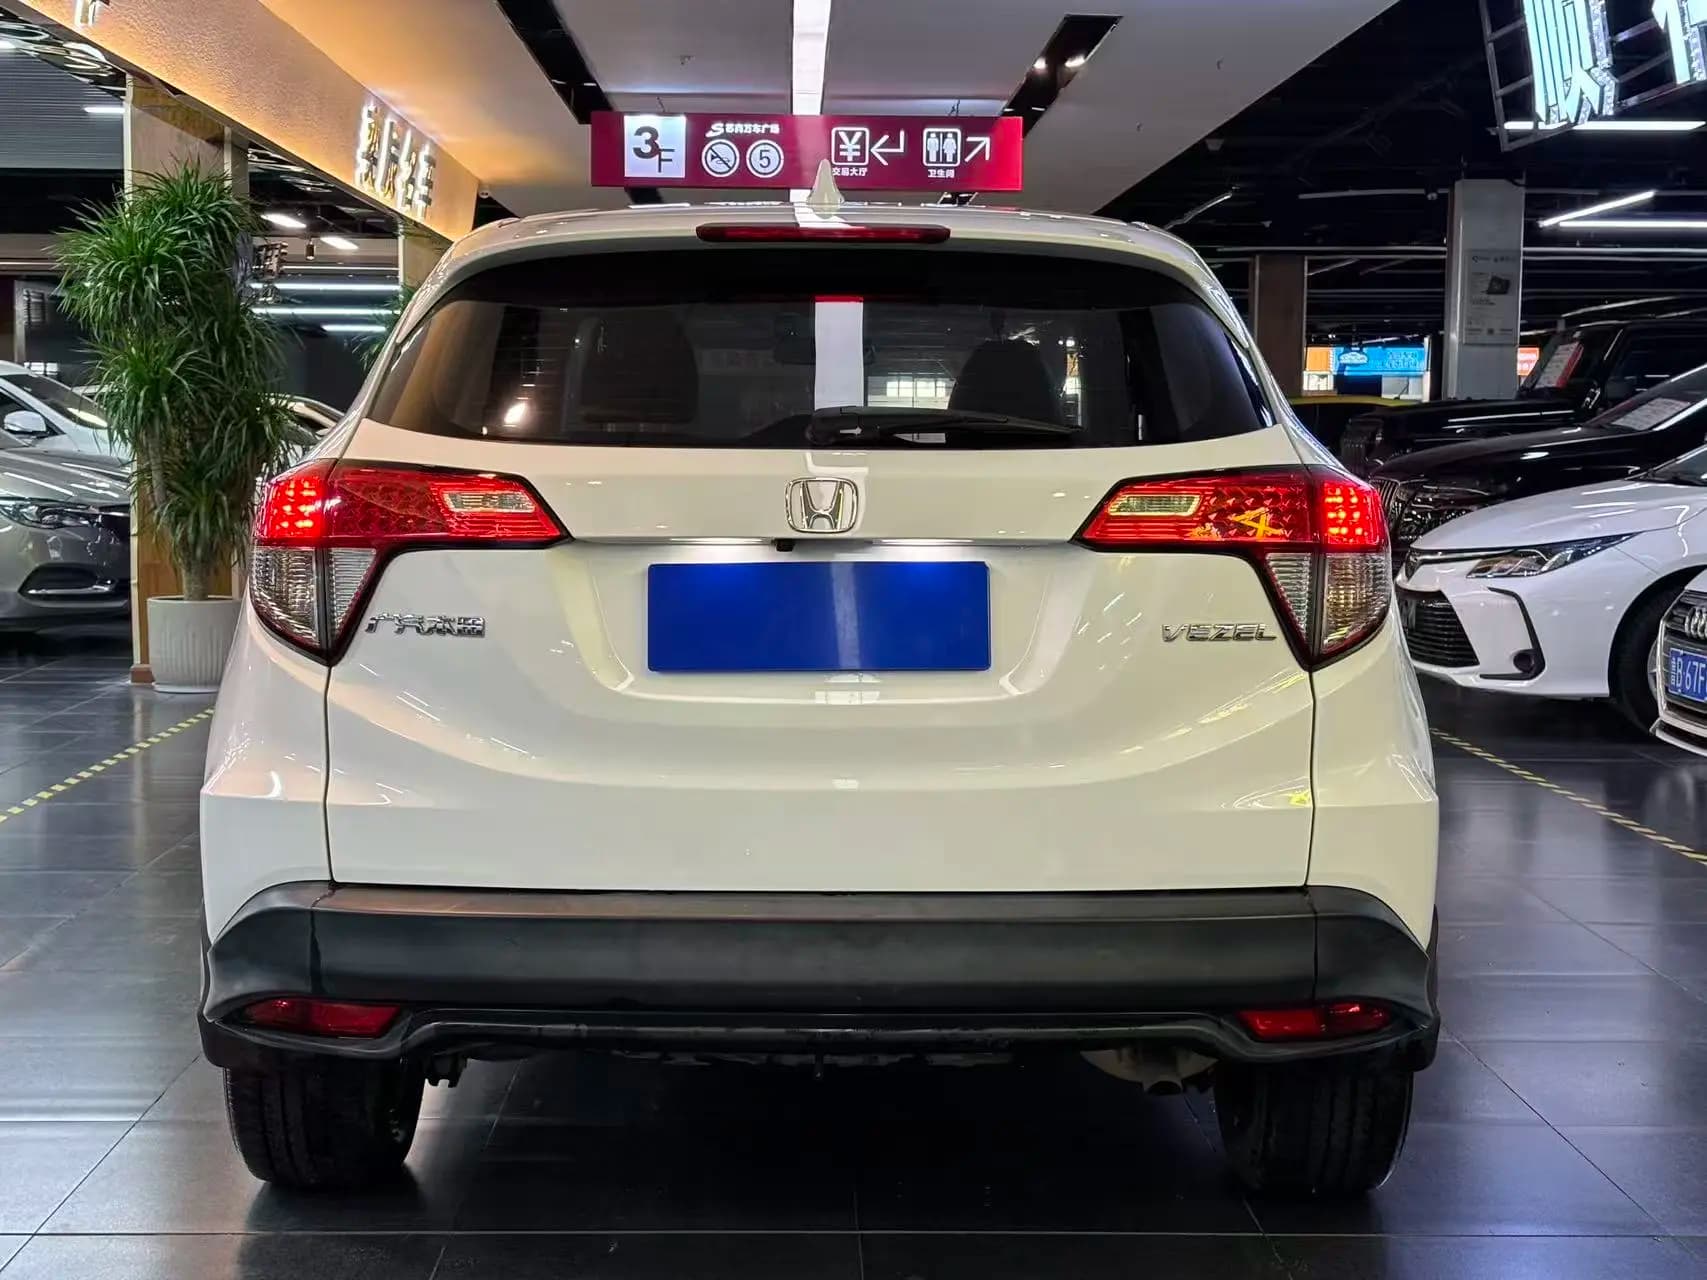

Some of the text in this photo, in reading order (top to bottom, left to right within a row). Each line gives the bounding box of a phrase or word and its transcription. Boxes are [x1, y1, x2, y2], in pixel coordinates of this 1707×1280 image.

[633, 126, 675, 173] 3F
[759, 149, 771, 168] 5
[832, 167, 868, 177] 交易大厅
[928, 169, 955, 178] 卫生间
[1162, 623, 1277, 641] VEZEL
